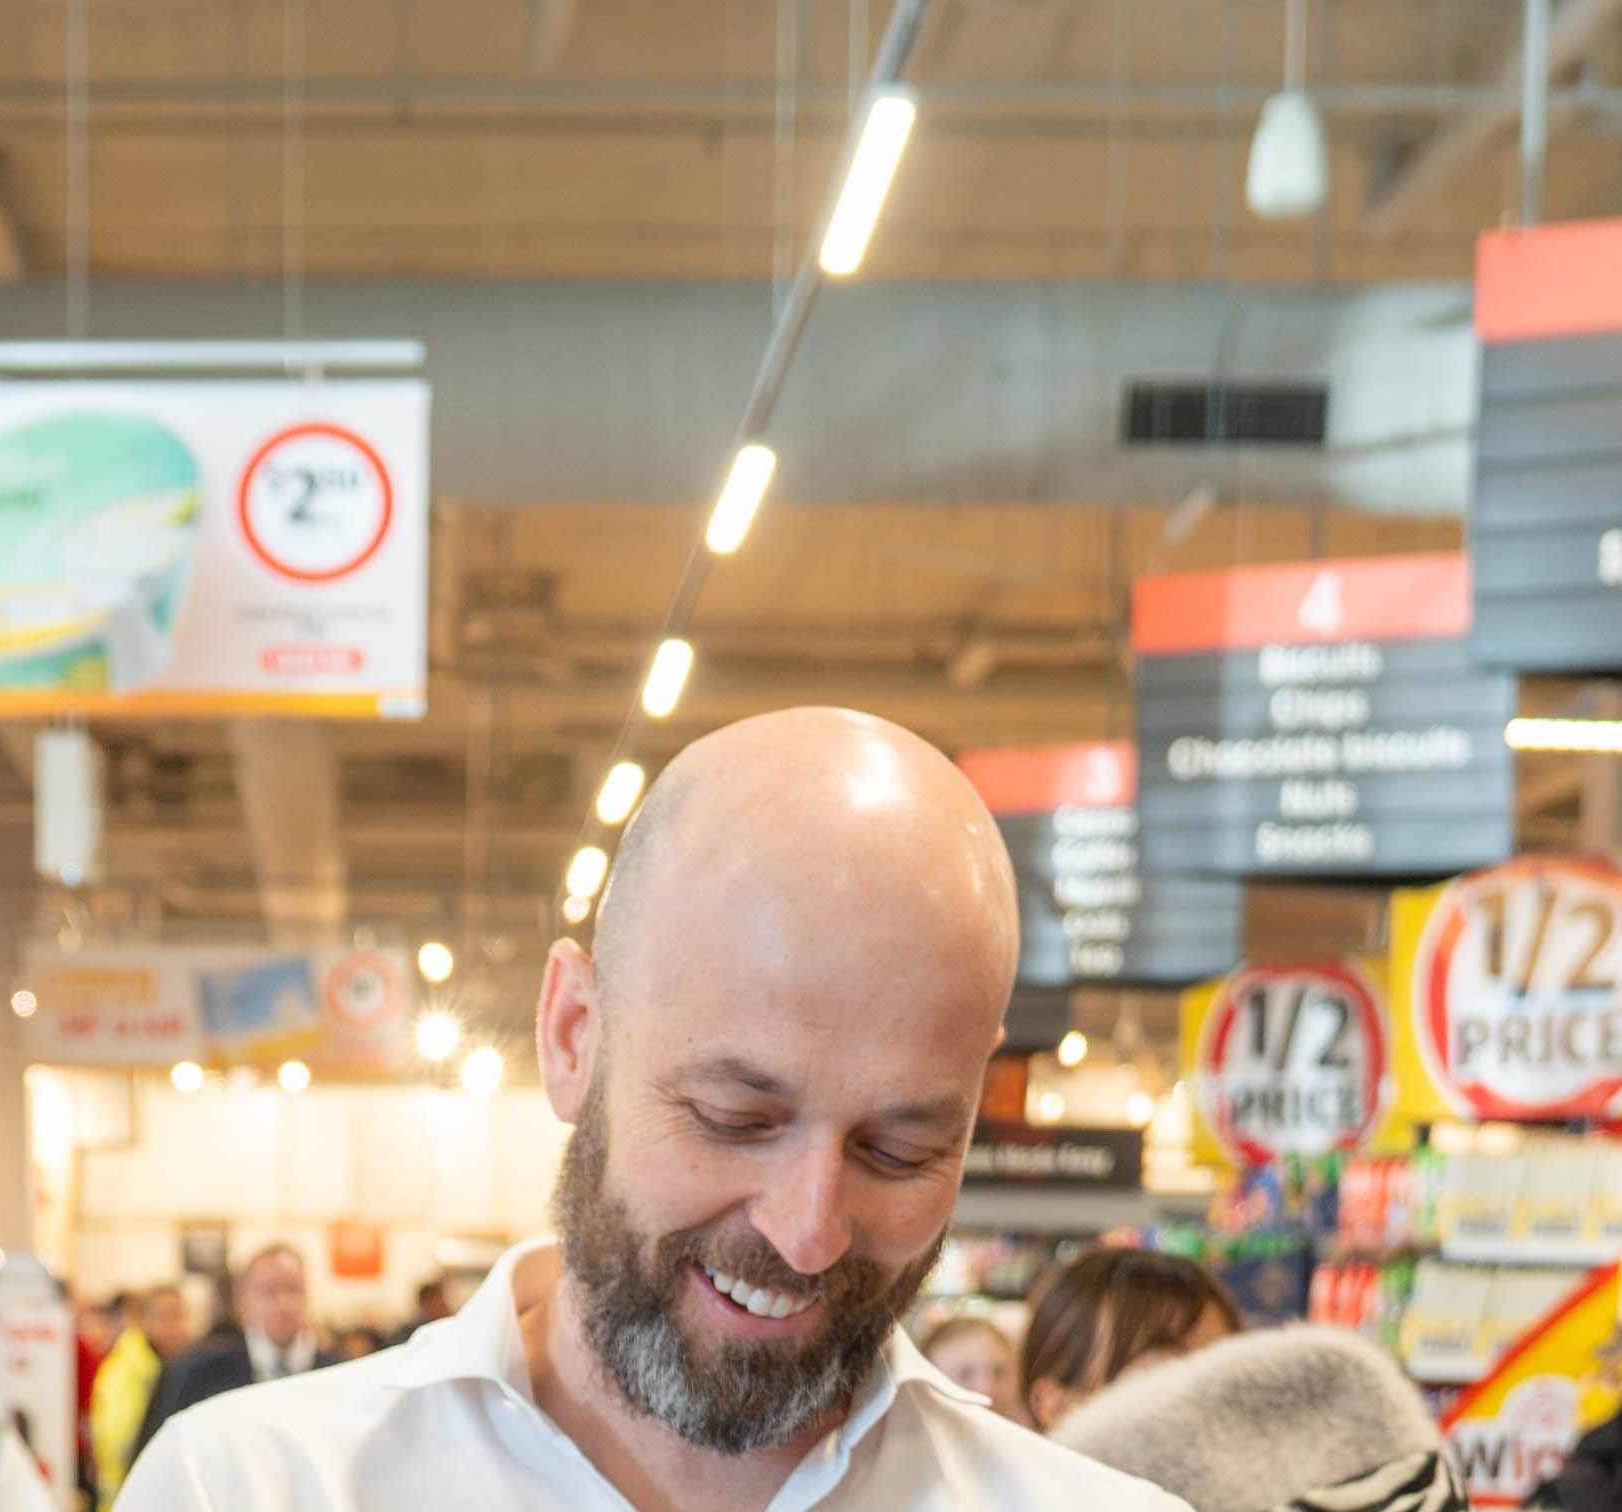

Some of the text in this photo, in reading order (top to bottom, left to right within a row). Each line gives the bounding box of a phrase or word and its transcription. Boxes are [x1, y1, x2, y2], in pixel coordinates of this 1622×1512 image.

[1297, 568, 1346, 632] 4
[1480, 882, 1617, 998] 1/2
[1245, 984, 1351, 1070] 1/2
[1231, 1082, 1362, 1131] PRICE
